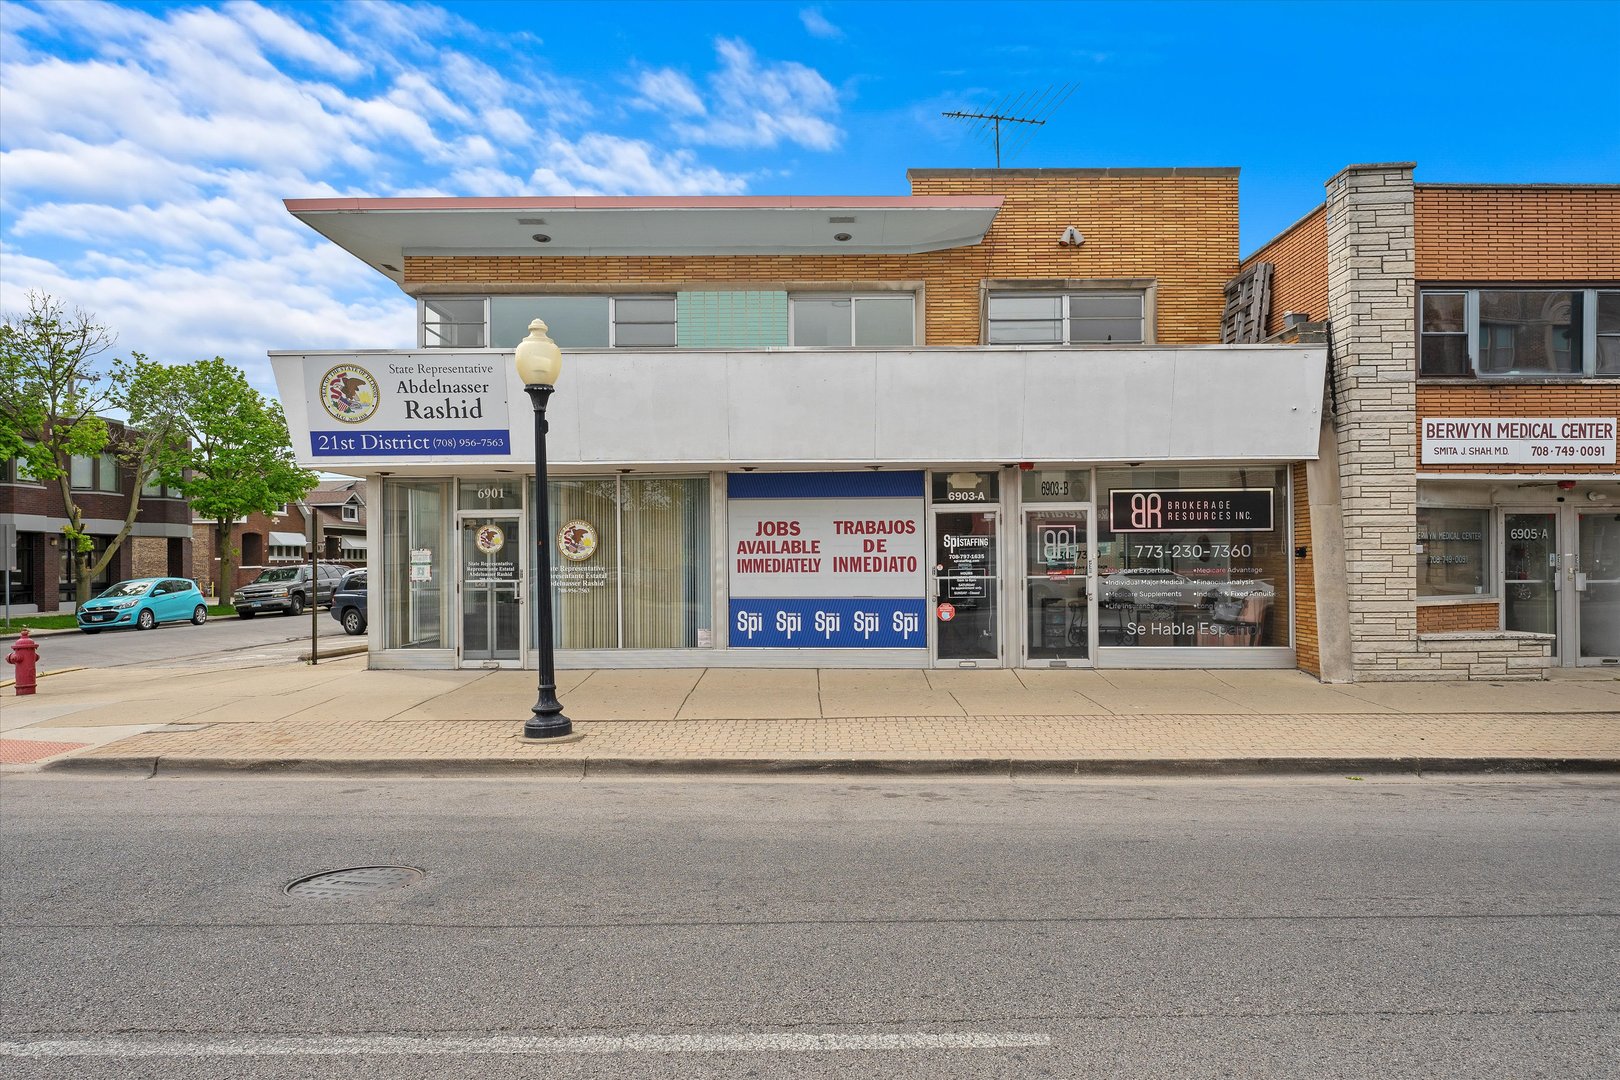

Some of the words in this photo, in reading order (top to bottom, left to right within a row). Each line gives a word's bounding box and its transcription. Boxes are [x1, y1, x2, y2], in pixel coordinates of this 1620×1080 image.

[389, 364, 414, 374] State
[417, 364, 494, 377] Representative
[396, 379, 489, 394] Abdelnasser
[404, 397, 484, 419] Rashid
[1426, 422, 1491, 439] BERWYN
[1497, 422, 1557, 439] MEDICAL
[1561, 422, 1613, 439] CENTER
[318, 435, 355, 450] 21st
[360, 434, 430, 450] District
[432, 438, 456, 449] (708)
[459, 438, 503, 447] 956-7563
[1433, 447, 1458, 456] SMITA
[477, 488, 505, 499] 6901
[948, 491, 985, 501] 6903-A
[1041, 481, 1069, 496] 6903-B
[1167, 500, 1231, 510] BROKERAGE
[1167, 511, 1231, 521] RESOURCES
[1235, 511, 1253, 520] INC.
[755, 520, 801, 537] JOBS
[833, 520, 916, 535] TRABAJOS
[1438, 531, 1460, 540] MEDICAL
[1461, 531, 1482, 540] CENTER
[737, 540, 821, 555] AVAILABLE
[863, 539, 887, 553] DE
[1134, 545, 1251, 559] 773-230-7360
[737, 558, 821, 573] IMMEDIATELY
[833, 556, 917, 573] INMEDIATO
[1227, 567, 1263, 575] Advantage
[1139, 591, 1182, 599] Supplements
[737, 611, 763, 640] Spi
[776, 611, 801, 640] Spi
[815, 611, 841, 640] Spi
[853, 611, 879, 640] Spi
[892, 611, 919, 640] Spi
[1126, 622, 1147, 636] Se
[1151, 622, 1195, 636] Habla
